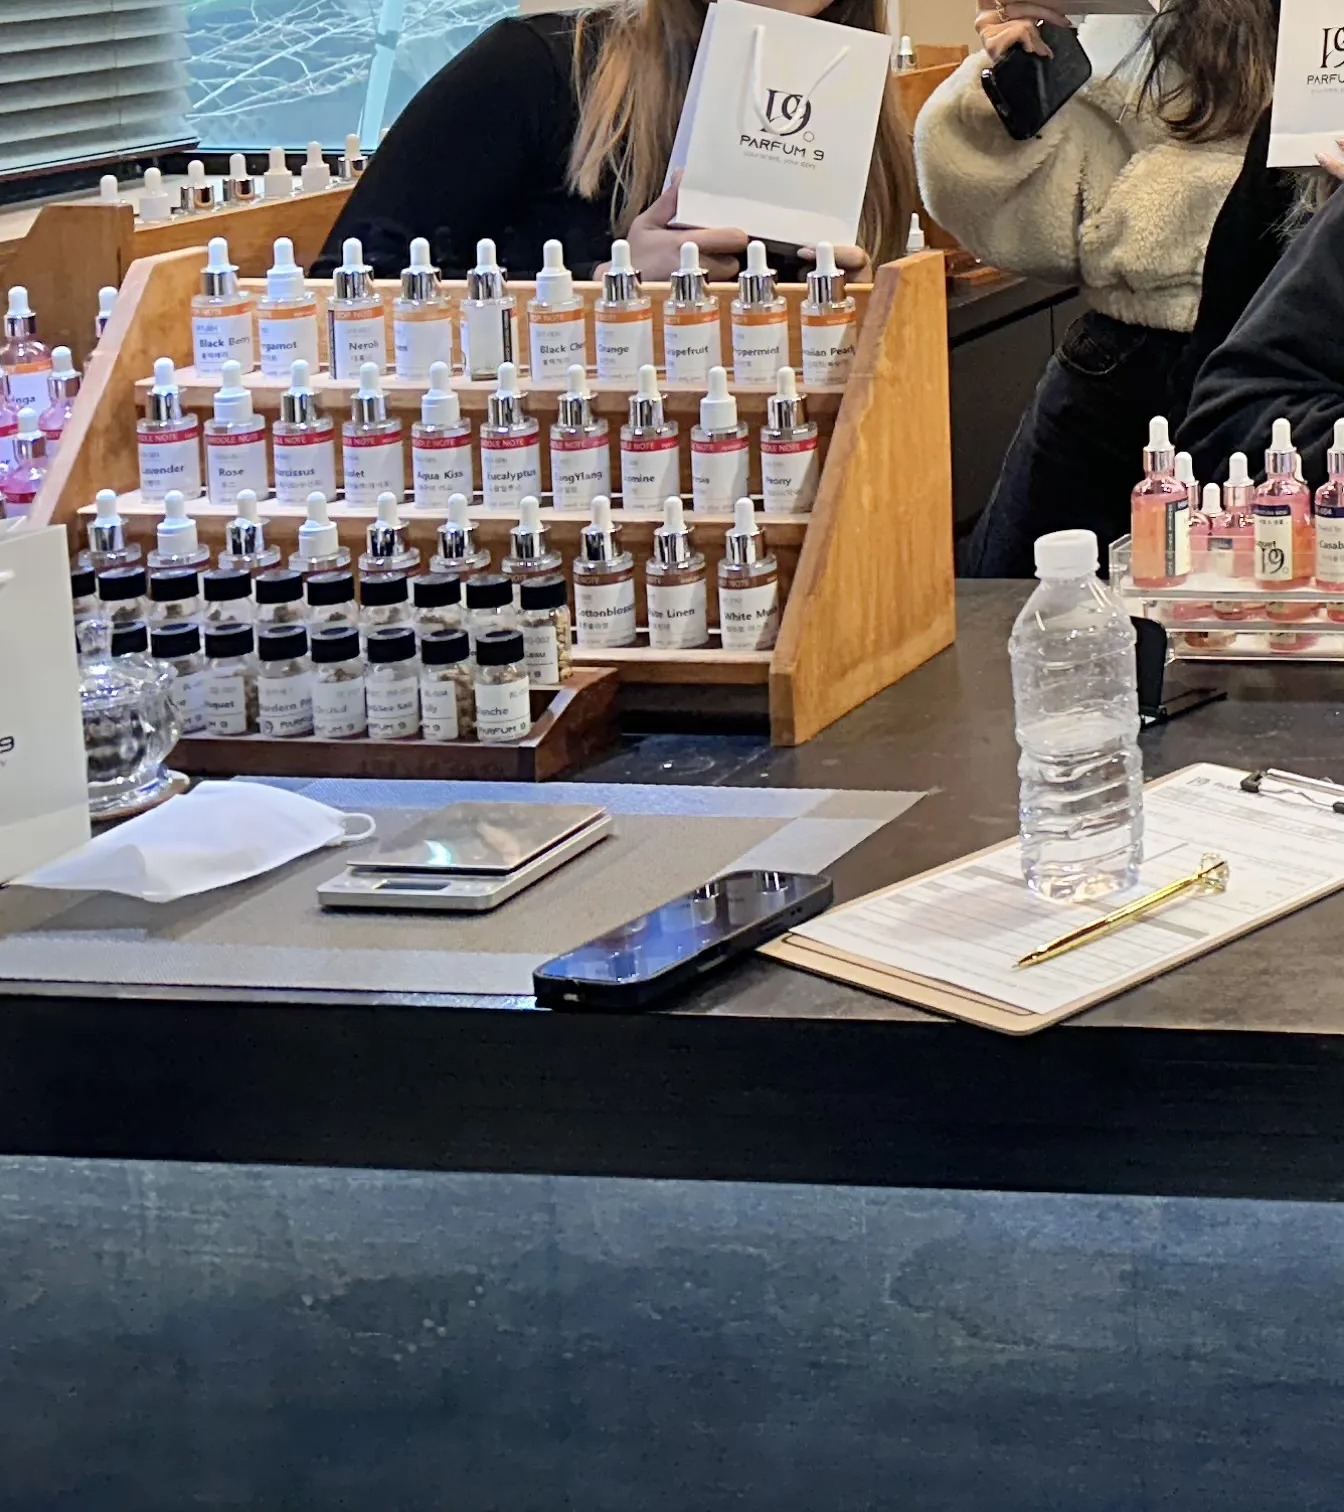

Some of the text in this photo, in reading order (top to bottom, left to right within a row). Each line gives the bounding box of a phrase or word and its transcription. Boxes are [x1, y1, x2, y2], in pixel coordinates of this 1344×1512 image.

[739, 134, 825, 161] PARFUM 9
[218, 467, 244, 476] Rose
[444, 469, 464, 480] Kiss
[667, 606, 696, 619] Linen
[724, 611, 752, 622] White
